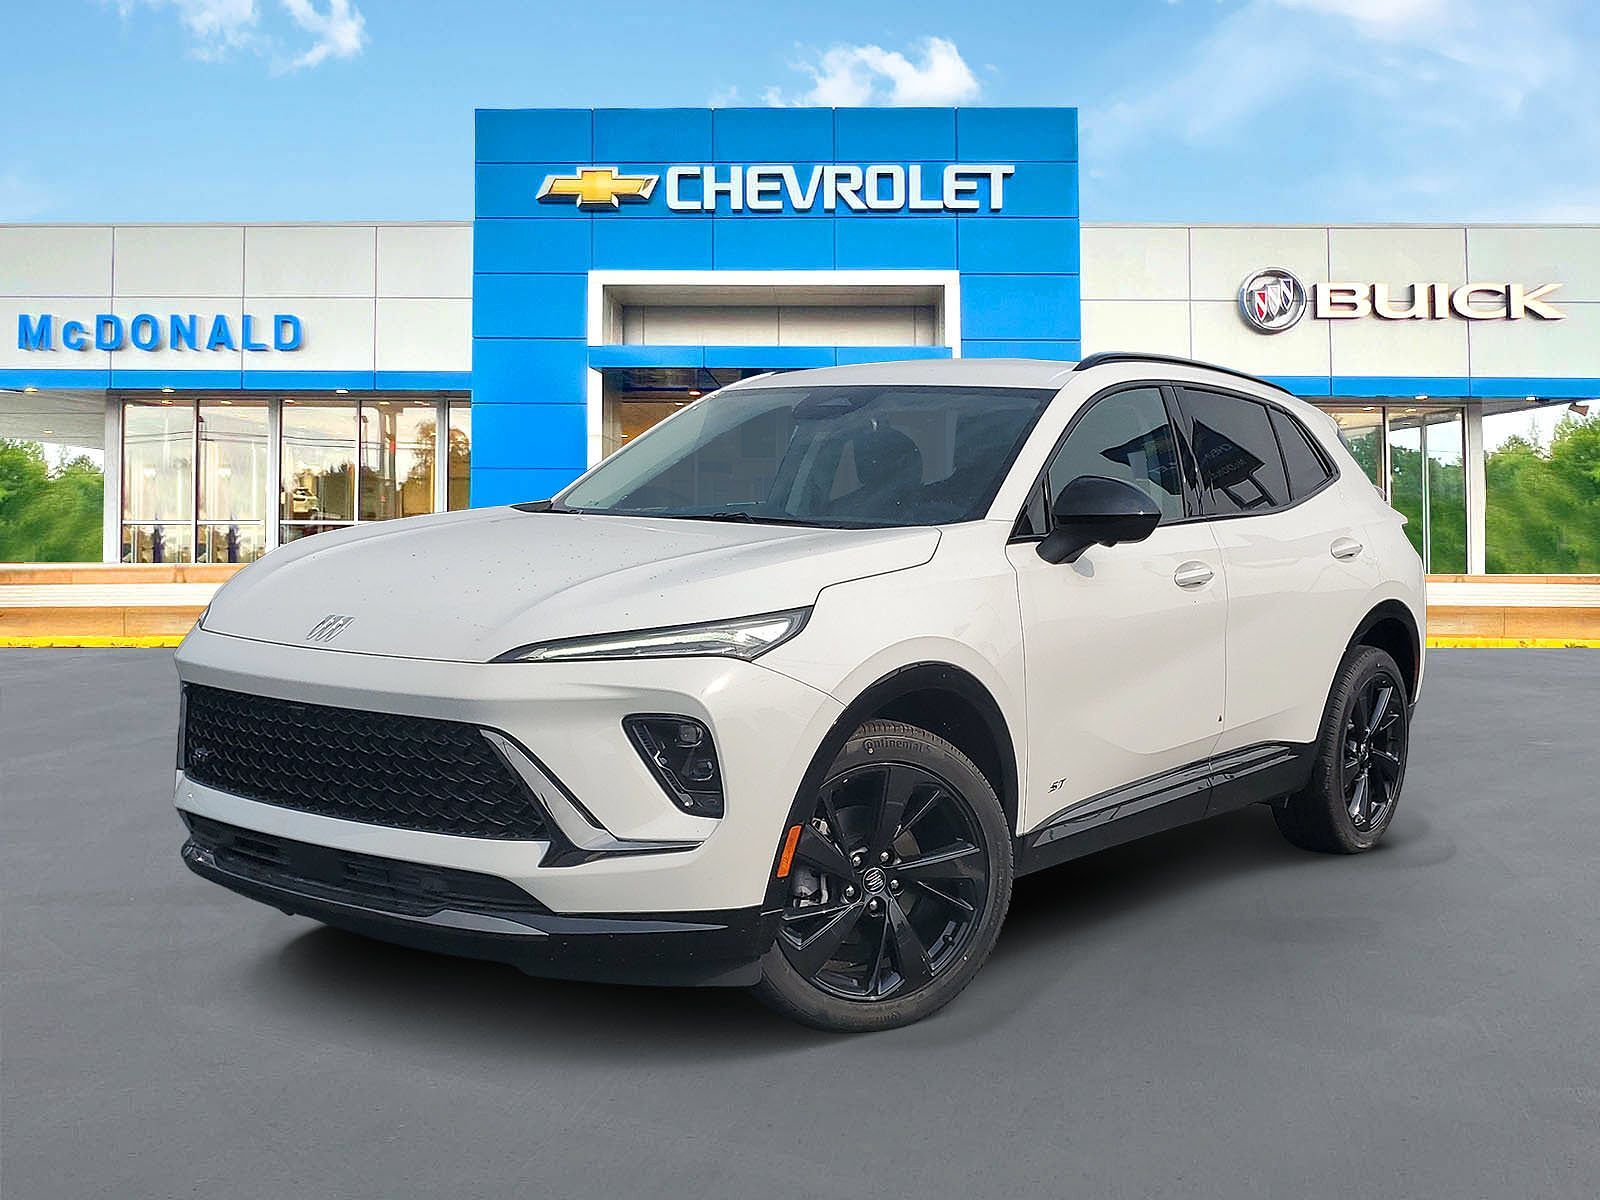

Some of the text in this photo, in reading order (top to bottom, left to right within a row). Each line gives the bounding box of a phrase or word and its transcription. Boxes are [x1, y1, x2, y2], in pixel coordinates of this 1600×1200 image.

[666, 164, 1015, 211] CHEVROLET
[1313, 281, 1566, 320] BUICK
[17, 313, 304, 351] McDONALD
